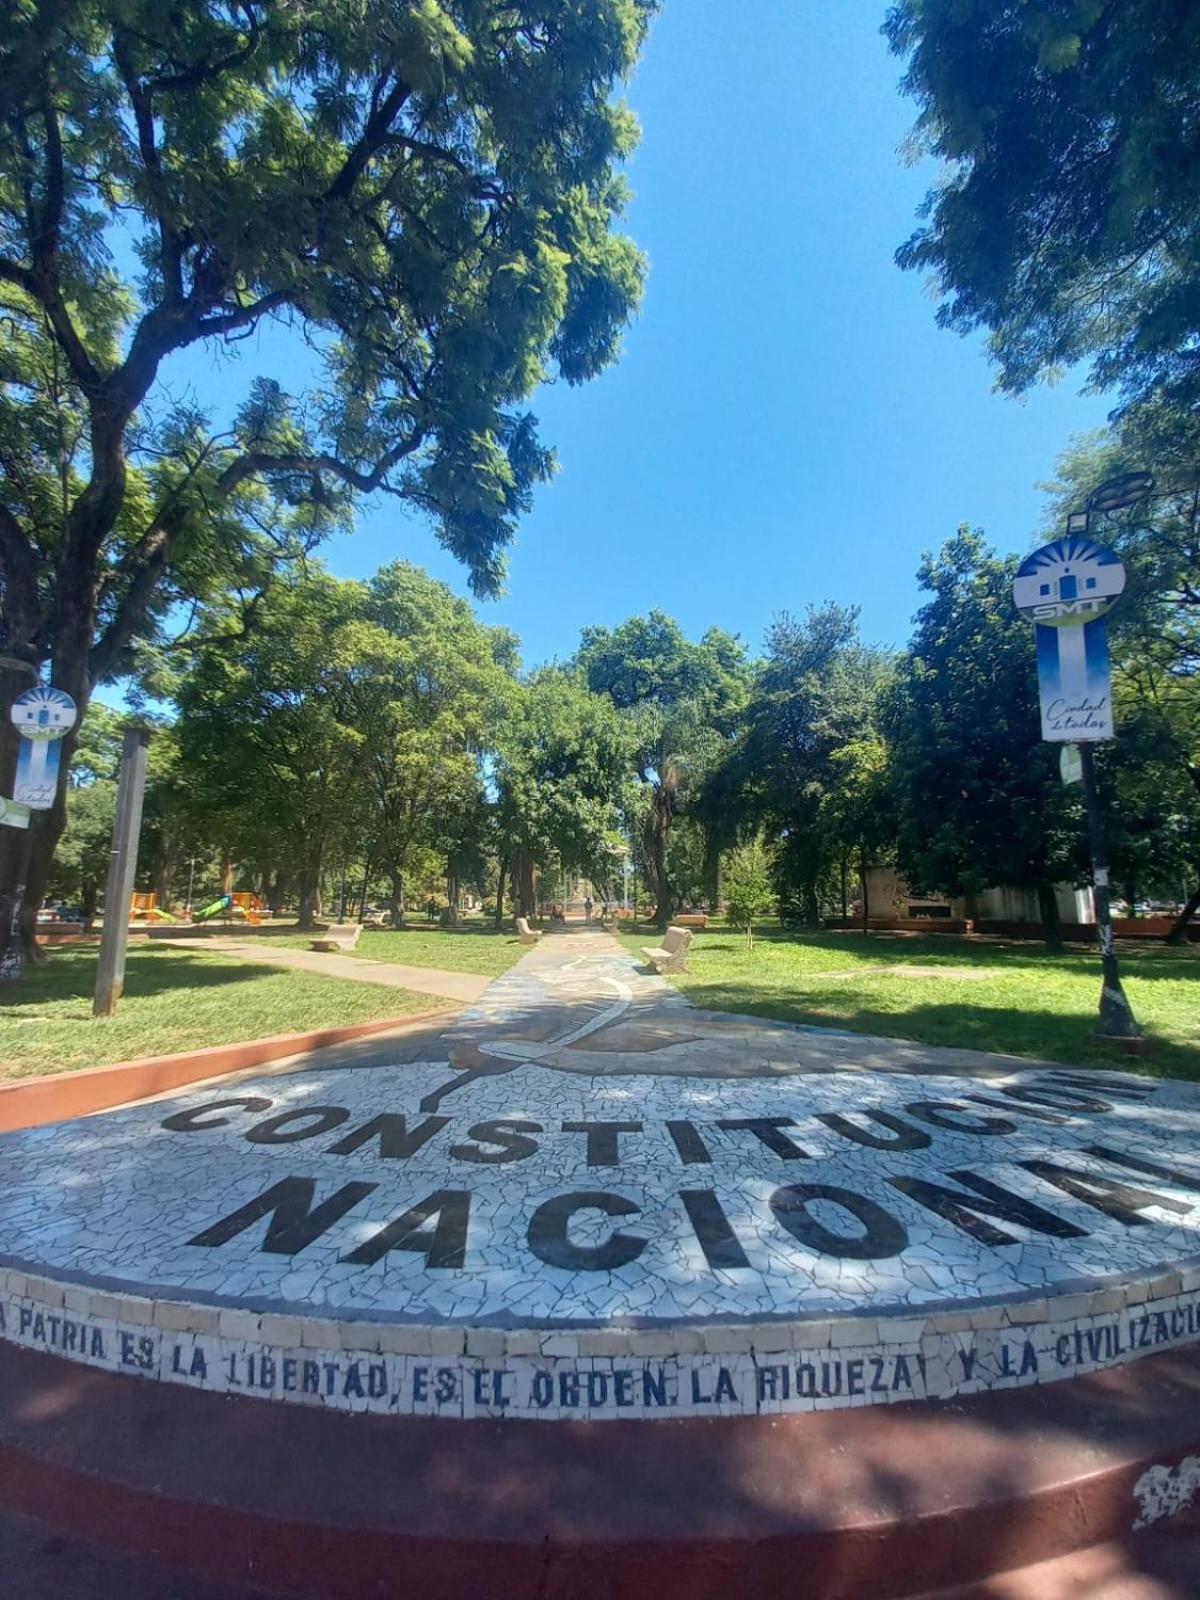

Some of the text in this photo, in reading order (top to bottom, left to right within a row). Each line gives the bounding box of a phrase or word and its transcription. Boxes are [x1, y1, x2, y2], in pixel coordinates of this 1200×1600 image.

[1032, 597, 1107, 620] SMT
[1046, 697, 1106, 722] Ciudad
[19, 1307, 108, 1359] PATRIA
[120, 1330, 155, 1369] ES
[172, 1344, 208, 1379] LA
[413, 1366, 459, 1403] ES
[474, 1369, 511, 1406] EL
[691, 1365, 738, 1404] LA
[756, 1354, 912, 1400] RIQUEZA
[958, 1348, 979, 1382] Y
[1000, 1340, 1039, 1377] LA
[1057, 1301, 1200, 1365] CIVILIZACI
